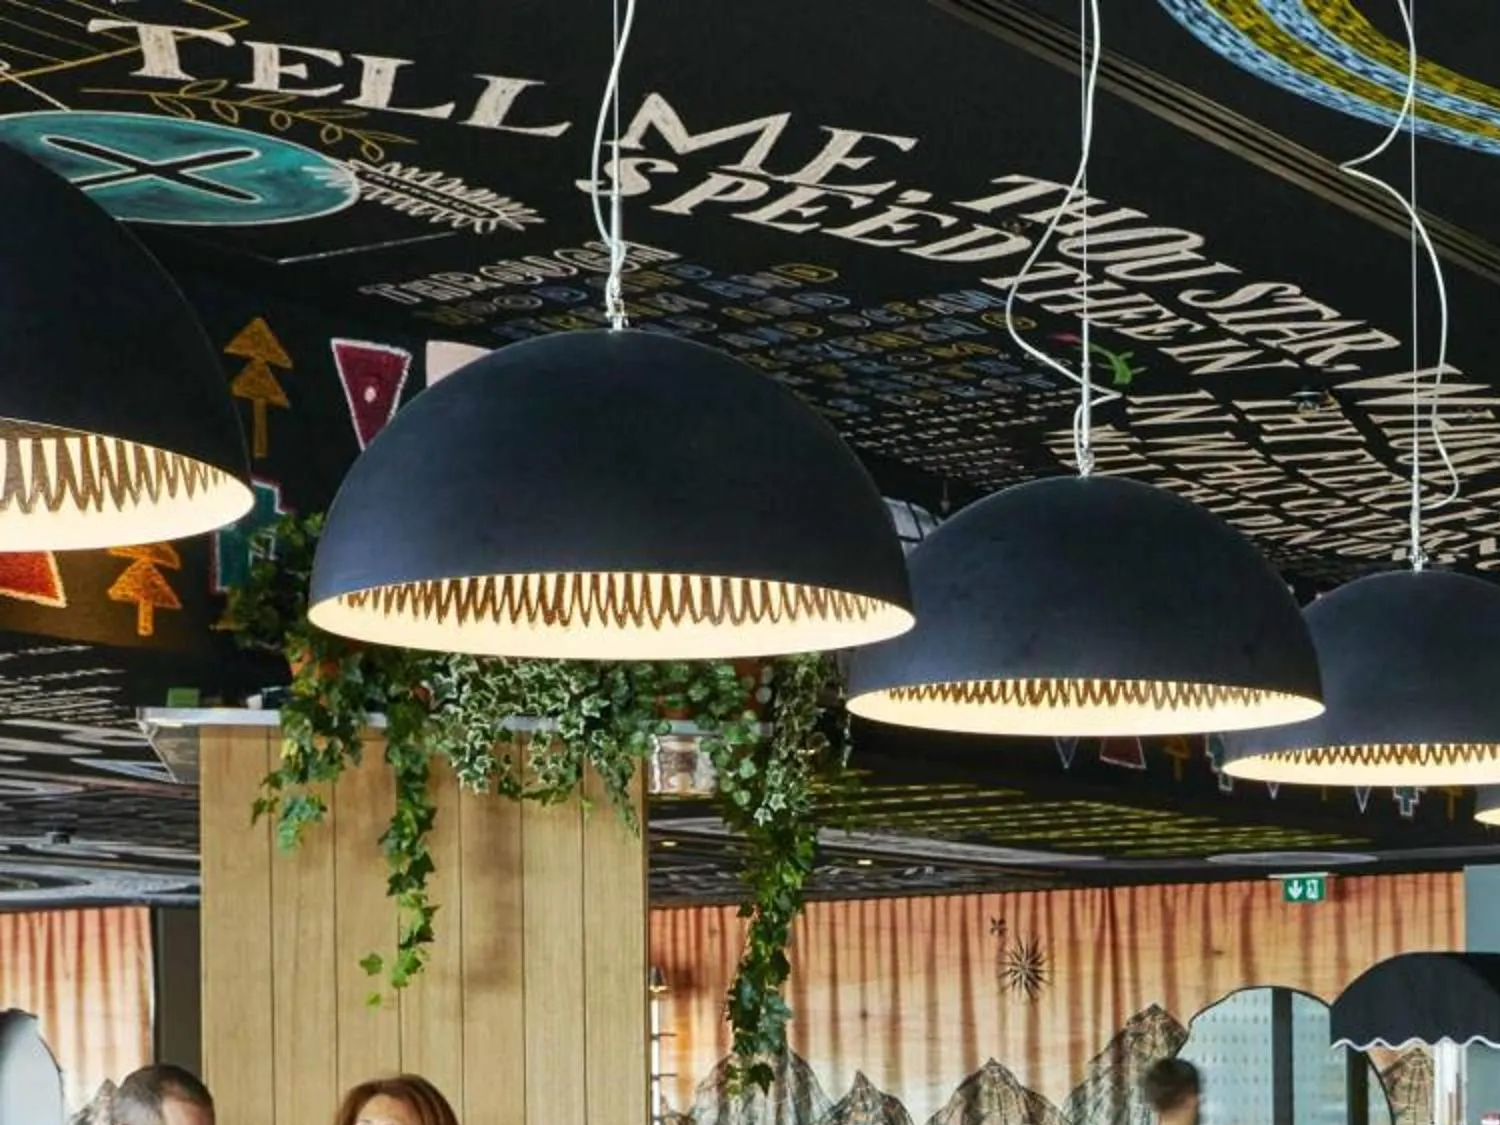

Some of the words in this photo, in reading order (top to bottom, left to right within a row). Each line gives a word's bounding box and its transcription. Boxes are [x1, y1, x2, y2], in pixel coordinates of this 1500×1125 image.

[87, 19, 572, 138] TELL
[956, 174, 1242, 282] THOU
[576, 158, 1031, 263] SPEED
[979, 261, 1205, 342] THEE
[1157, 337, 1301, 376] IN
[1124, 389, 1239, 427] IN
[1144, 430, 1320, 499] WHAT
